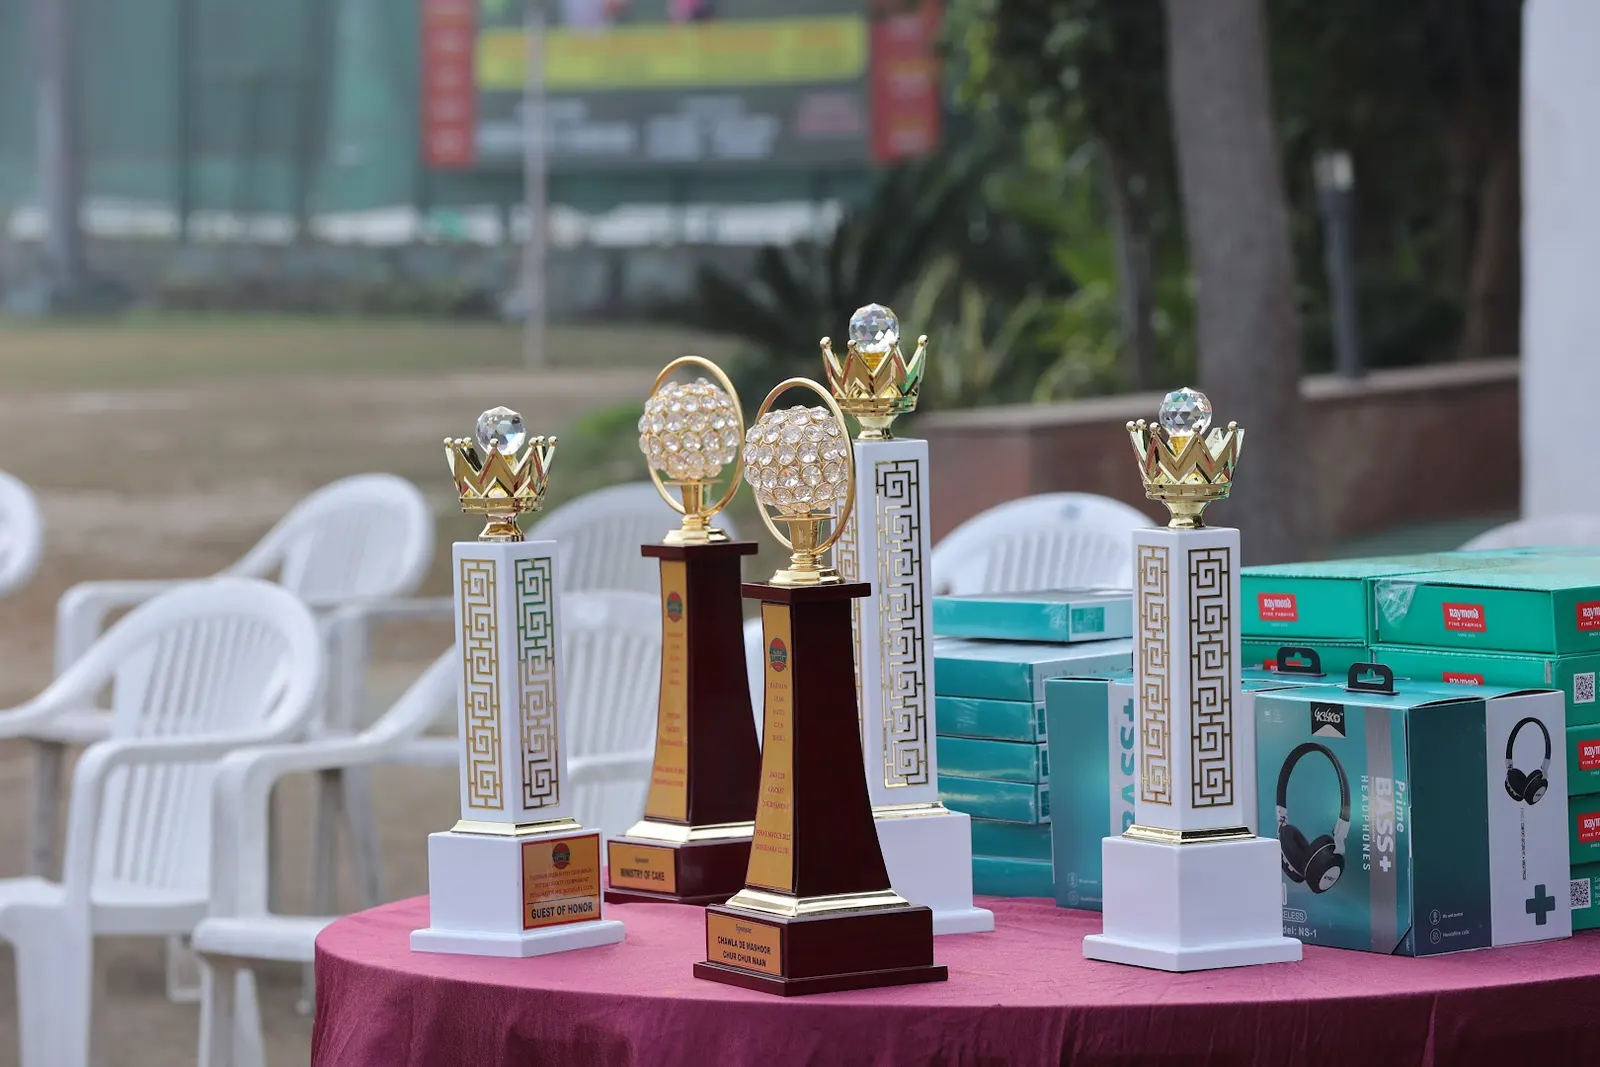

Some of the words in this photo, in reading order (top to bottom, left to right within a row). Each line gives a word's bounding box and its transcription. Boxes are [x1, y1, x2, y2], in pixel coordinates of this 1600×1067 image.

[1449, 608, 1479, 621] Raymond
[1583, 607, 1600, 620] Raym
[1583, 745, 1600, 759] Raym
[1395, 779, 1407, 833] Prime
[1360, 775, 1371, 871] HEADPHONES
[1375, 777, 1395, 873] BASS+
[1583, 817, 1600, 831] Raym
[531, 906, 555, 920] GUEST
[556, 905, 566, 916] OF
[567, 901, 594, 914] HONOR
[1283, 910, 1305, 921] ELESS
[1283, 926, 1297, 936] del:
[1298, 927, 1318, 938] NS-1
[717, 935, 739, 949] CHAWLA
[722, 950, 737, 961] CHUR
[737, 953, 752, 964] CHUR
